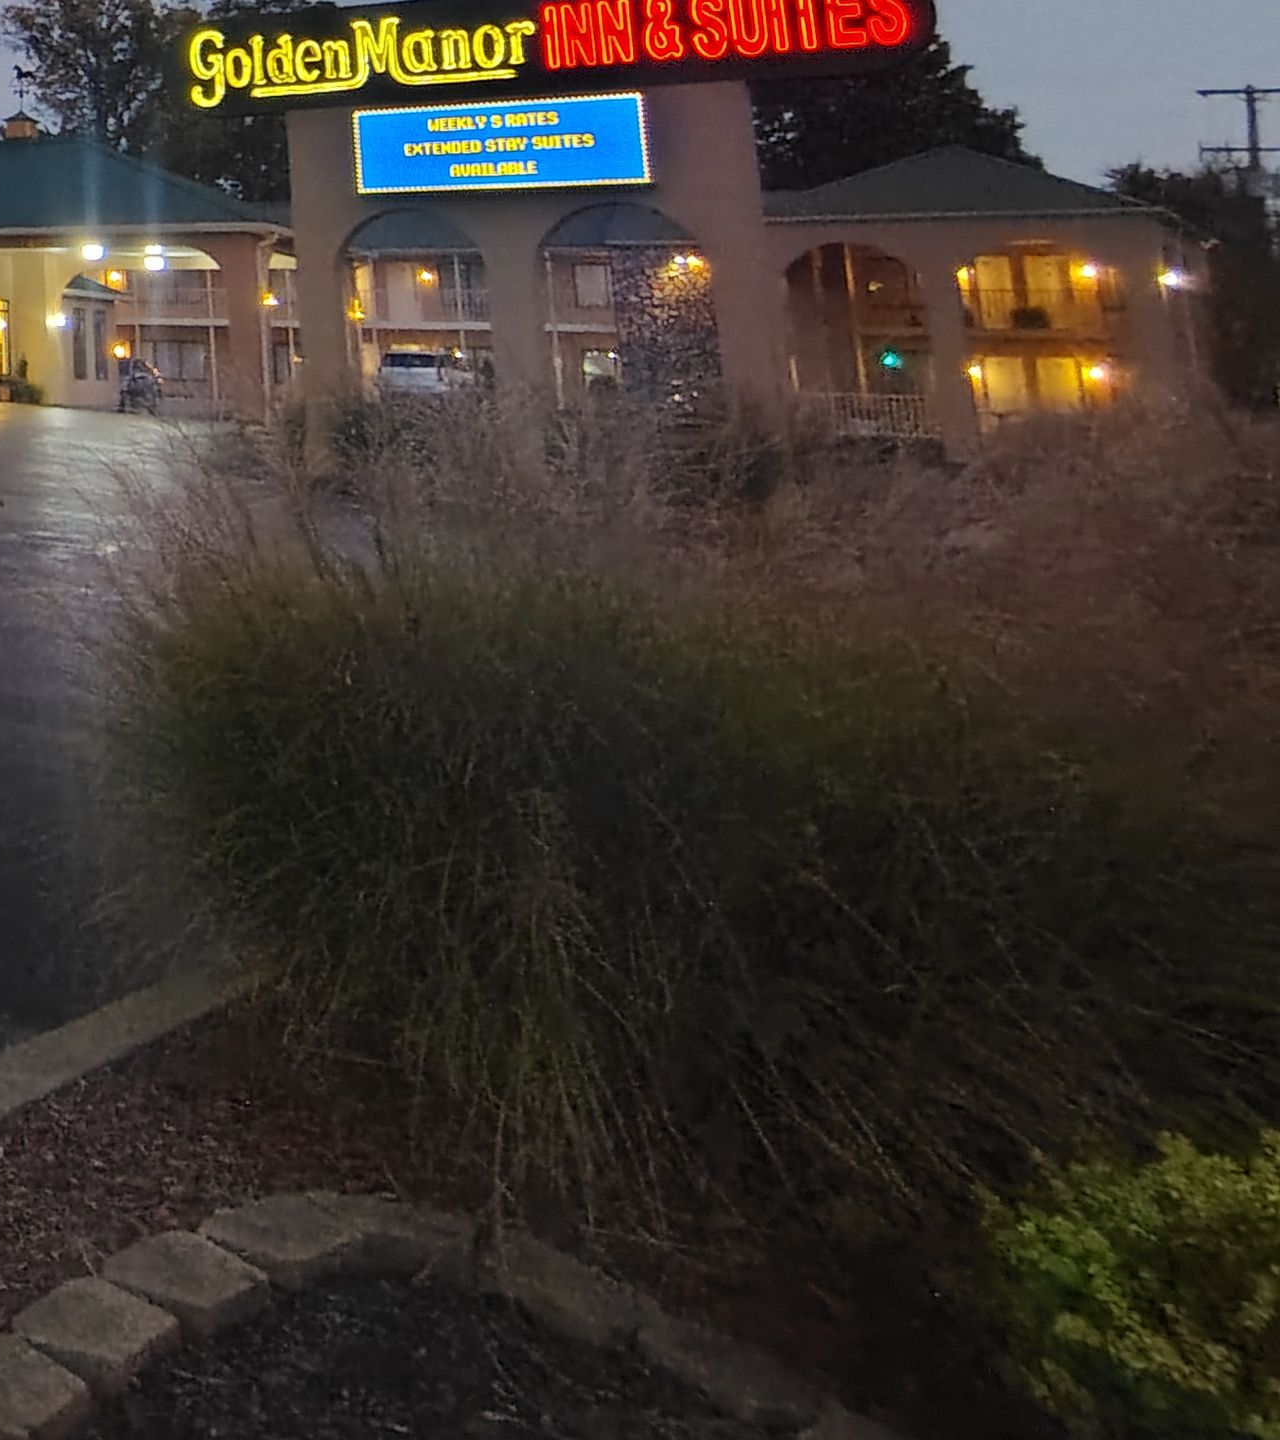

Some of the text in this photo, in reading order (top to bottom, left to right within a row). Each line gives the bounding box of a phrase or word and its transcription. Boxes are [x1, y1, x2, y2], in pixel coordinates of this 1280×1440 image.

[189, 29, 354, 108] Golden
[350, 15, 536, 87] Manor
[427, 115, 488, 132] WEEKLY
[505, 111, 560, 128] RATES
[403, 133, 595, 157] EXTENDED STAY SUITES
[449, 160, 538, 178] AVAILABLE
